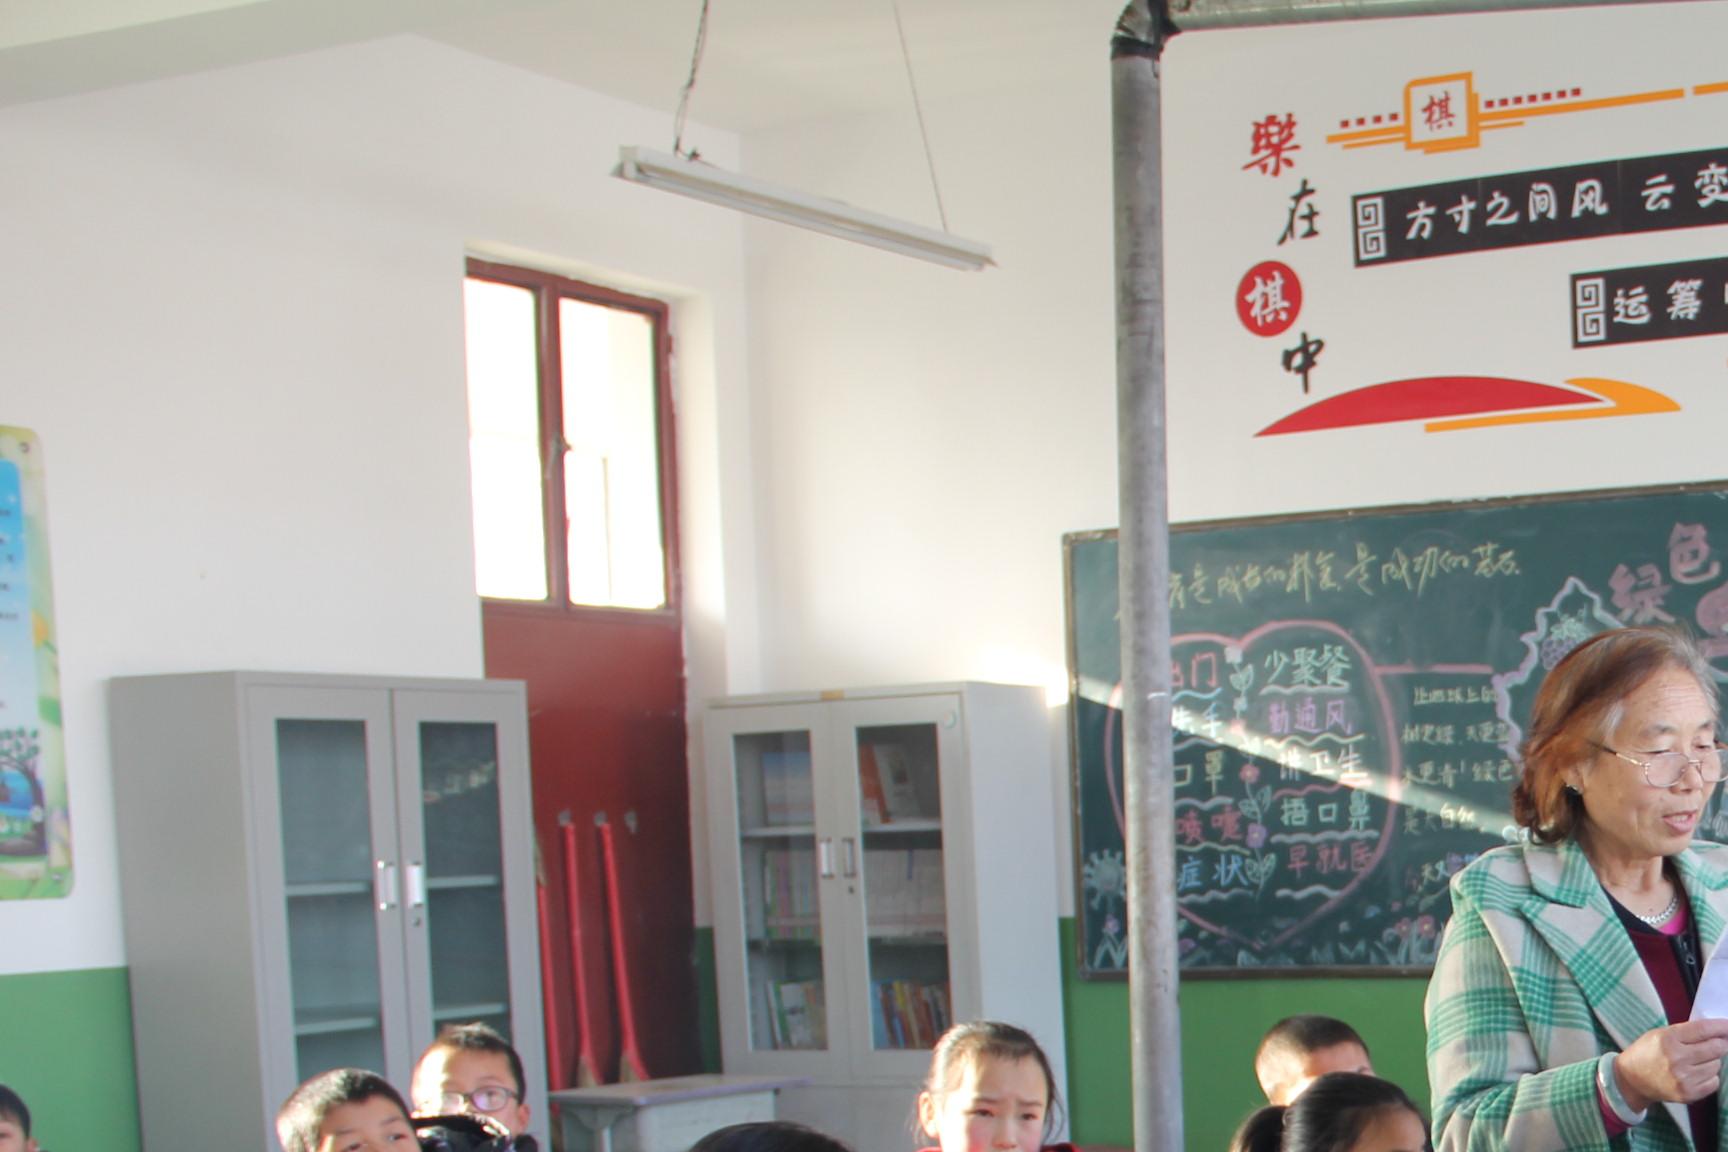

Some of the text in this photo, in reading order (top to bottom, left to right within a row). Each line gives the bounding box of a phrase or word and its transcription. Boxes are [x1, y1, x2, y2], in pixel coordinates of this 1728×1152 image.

[1421, 91, 1456, 131] 棋
[1264, 645, 1350, 687] 少聚餐
